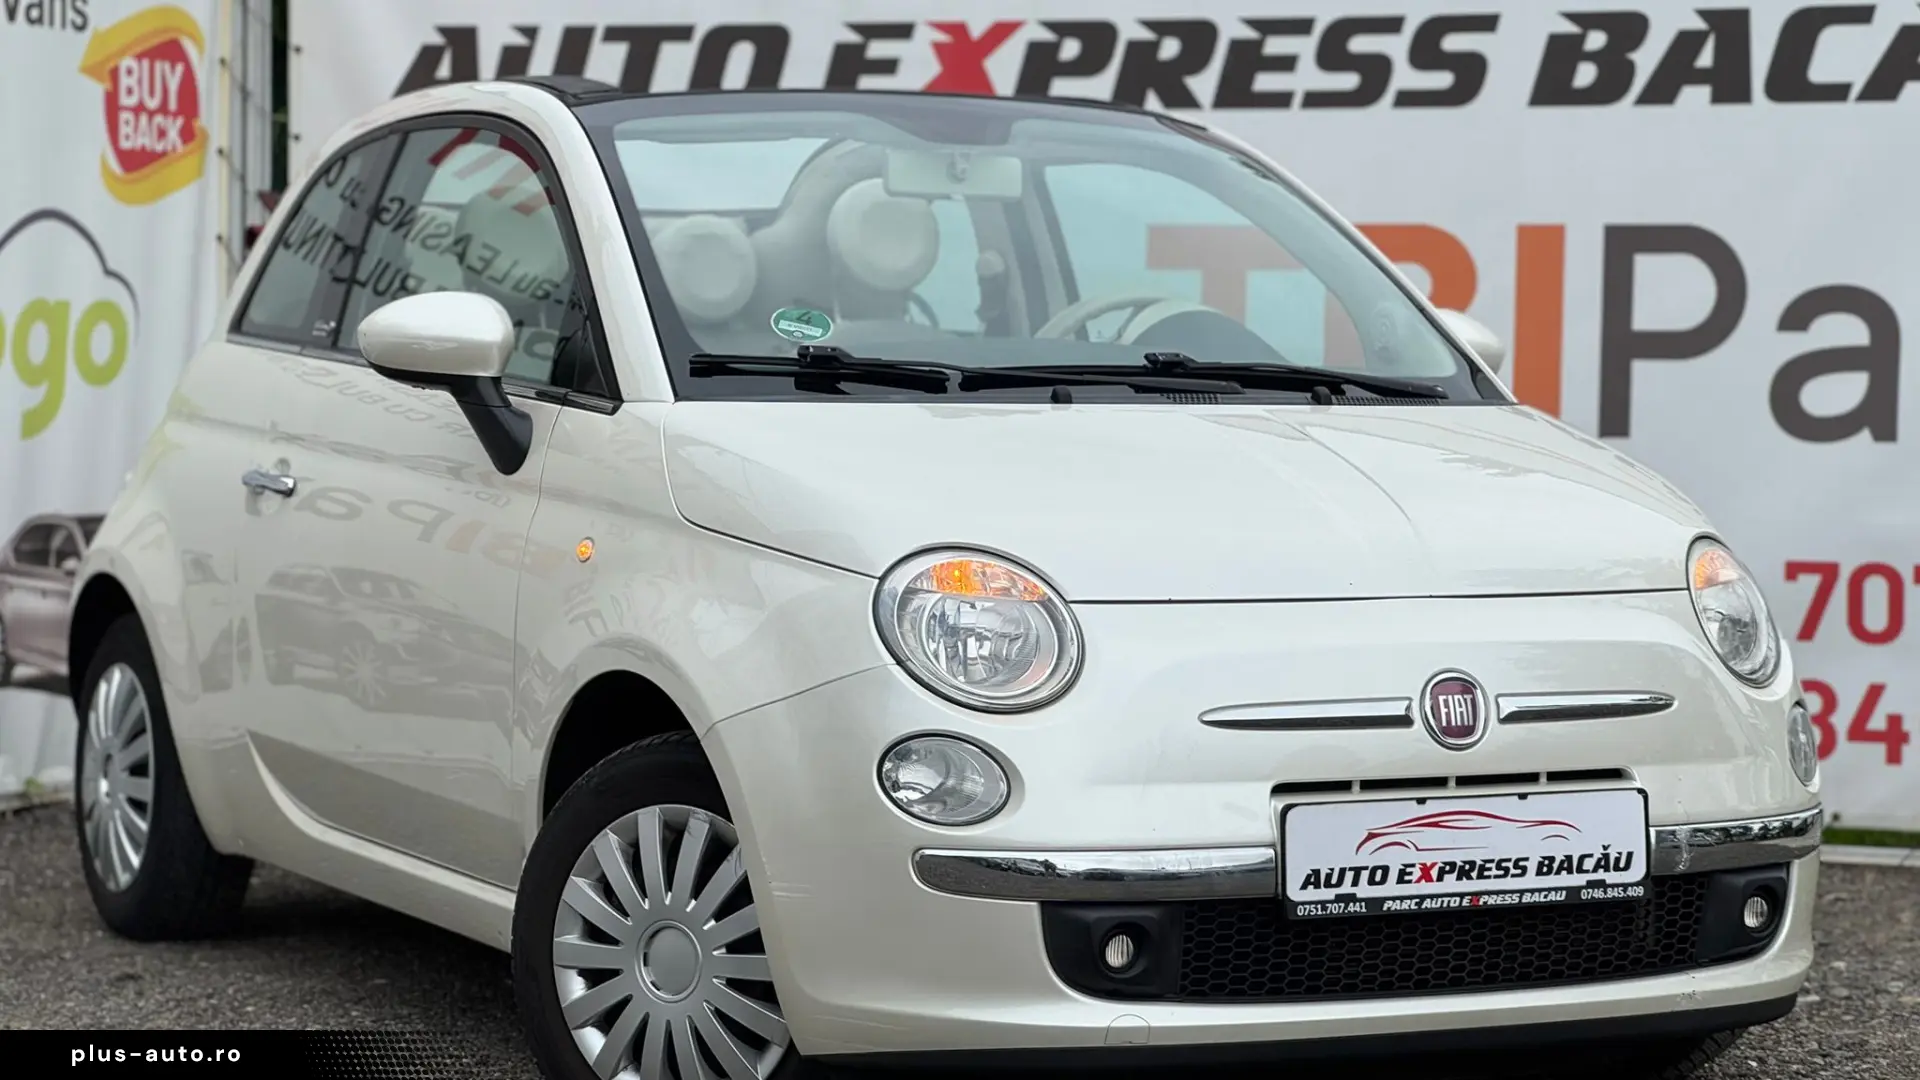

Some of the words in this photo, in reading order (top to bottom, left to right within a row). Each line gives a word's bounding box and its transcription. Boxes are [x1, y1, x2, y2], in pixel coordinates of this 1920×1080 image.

[118, 57, 184, 111] BUY
[393, 24, 791, 98] AUTO
[824, 14, 1501, 112] EXPRESS
[118, 110, 184, 153] BACK
[0, 297, 128, 441] go
[1784, 560, 1920, 645] 70
[1438, 694, 1474, 727] FIAT
[1299, 864, 1390, 891] AUTO
[1395, 857, 1530, 885] EXPRESS
[1535, 844, 1634, 877] BACĂU
[1297, 901, 1367, 916] 0751.707.441
[1382, 898, 1418, 911] PARC
[1421, 896, 1461, 909] AUTO
[1462, 891, 1520, 907] EXPRESS
[1521, 890, 1567, 904] BACAU
[1580, 885, 1645, 900] 0746.845.409
